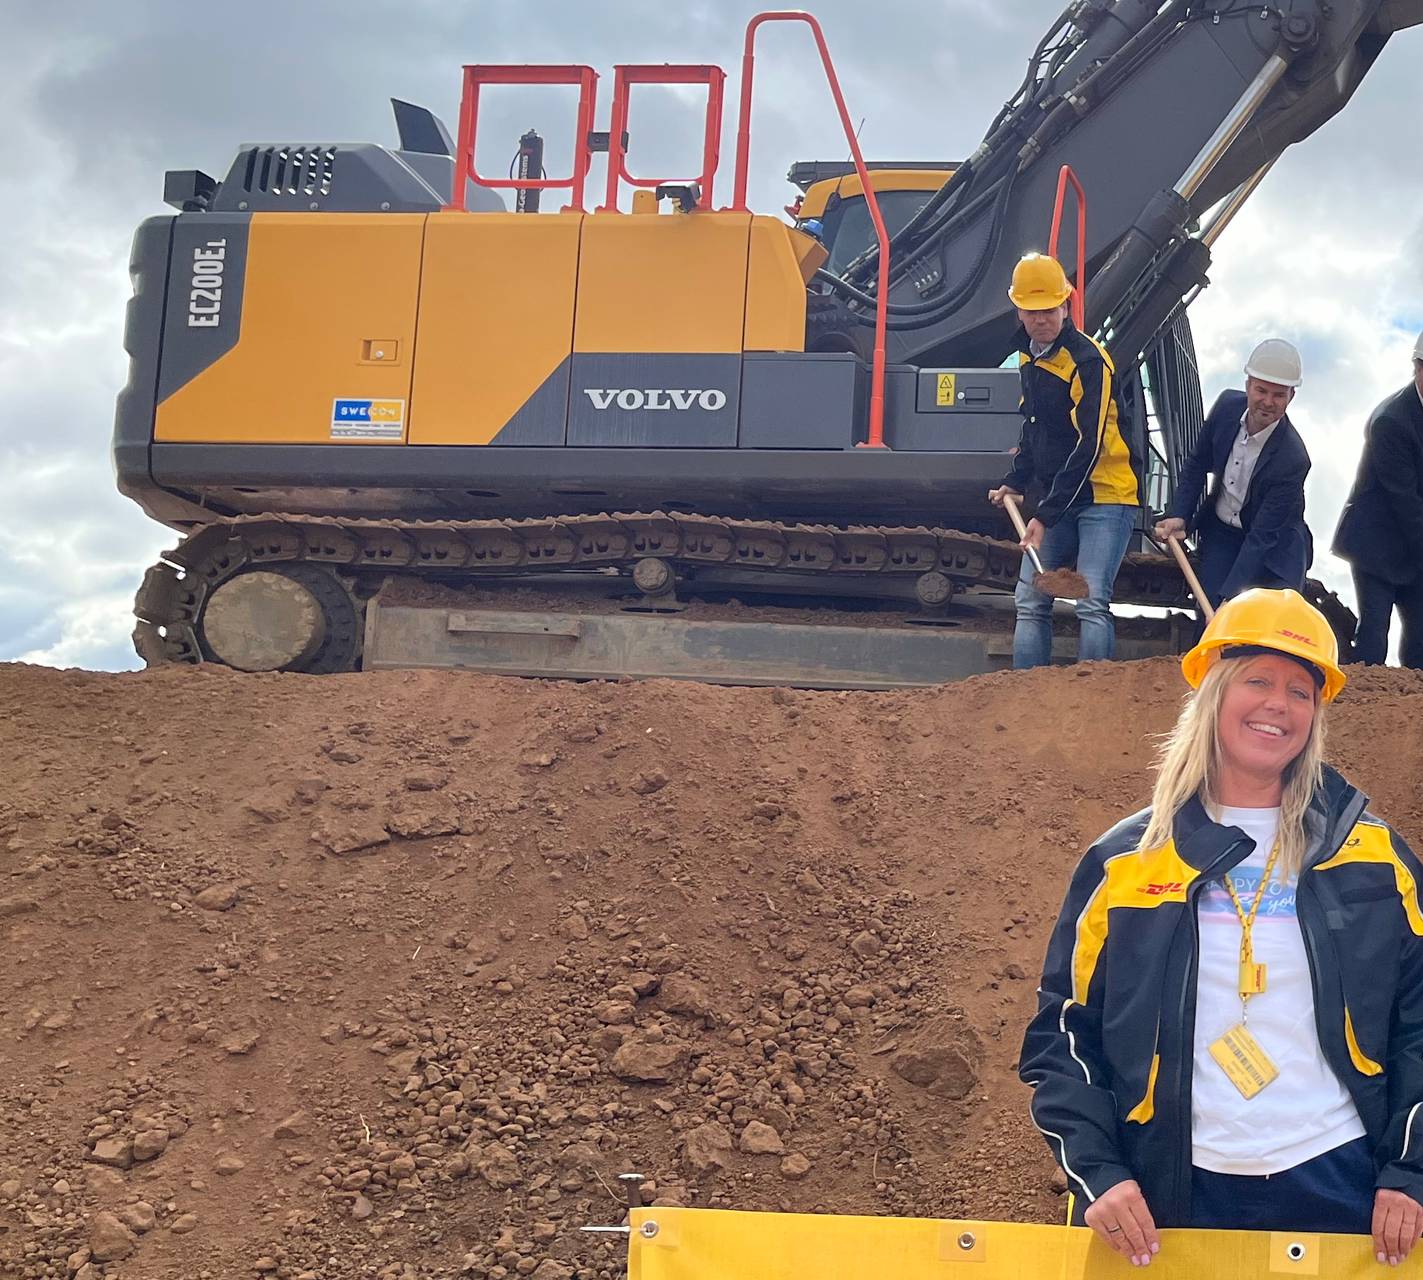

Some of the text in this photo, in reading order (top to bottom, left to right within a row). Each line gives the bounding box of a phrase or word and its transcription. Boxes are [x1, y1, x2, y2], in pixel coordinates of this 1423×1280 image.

[584, 389, 727, 411] VOLVO
[1279, 629, 1315, 647] DHL
[1142, 882, 1184, 895] DHL
